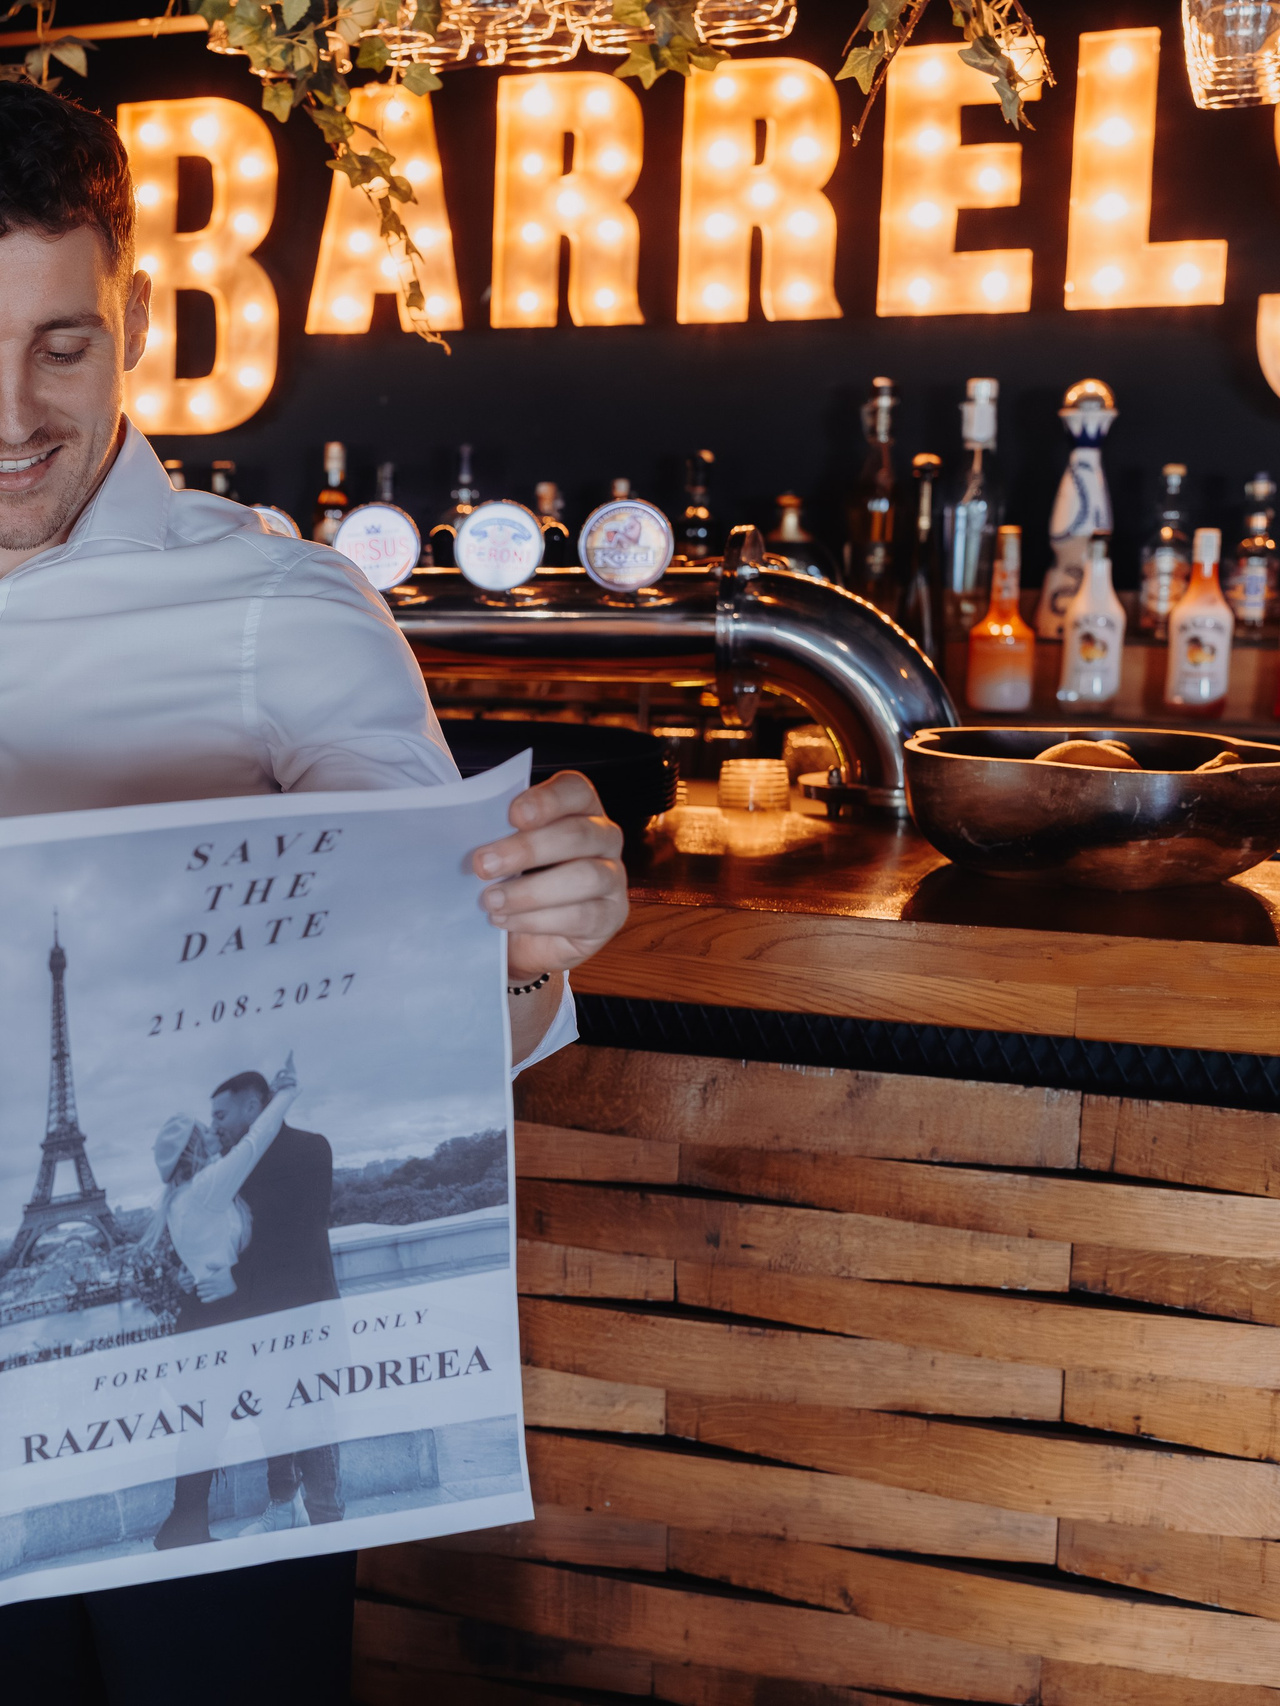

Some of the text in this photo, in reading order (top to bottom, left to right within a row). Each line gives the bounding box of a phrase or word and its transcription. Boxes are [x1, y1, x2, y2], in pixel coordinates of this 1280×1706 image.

[117, 27, 1280, 435] BARREL
[186, 828, 343, 871] SAVE
[204, 871, 317, 913] THE
[177, 910, 330, 964] DATE
[148, 972, 356, 1037] 21.08.2027
[93, 1308, 429, 1392] FOREVER VIBES ONLY
[21, 1345, 492, 1465] RAZVAN & ANDREEA
